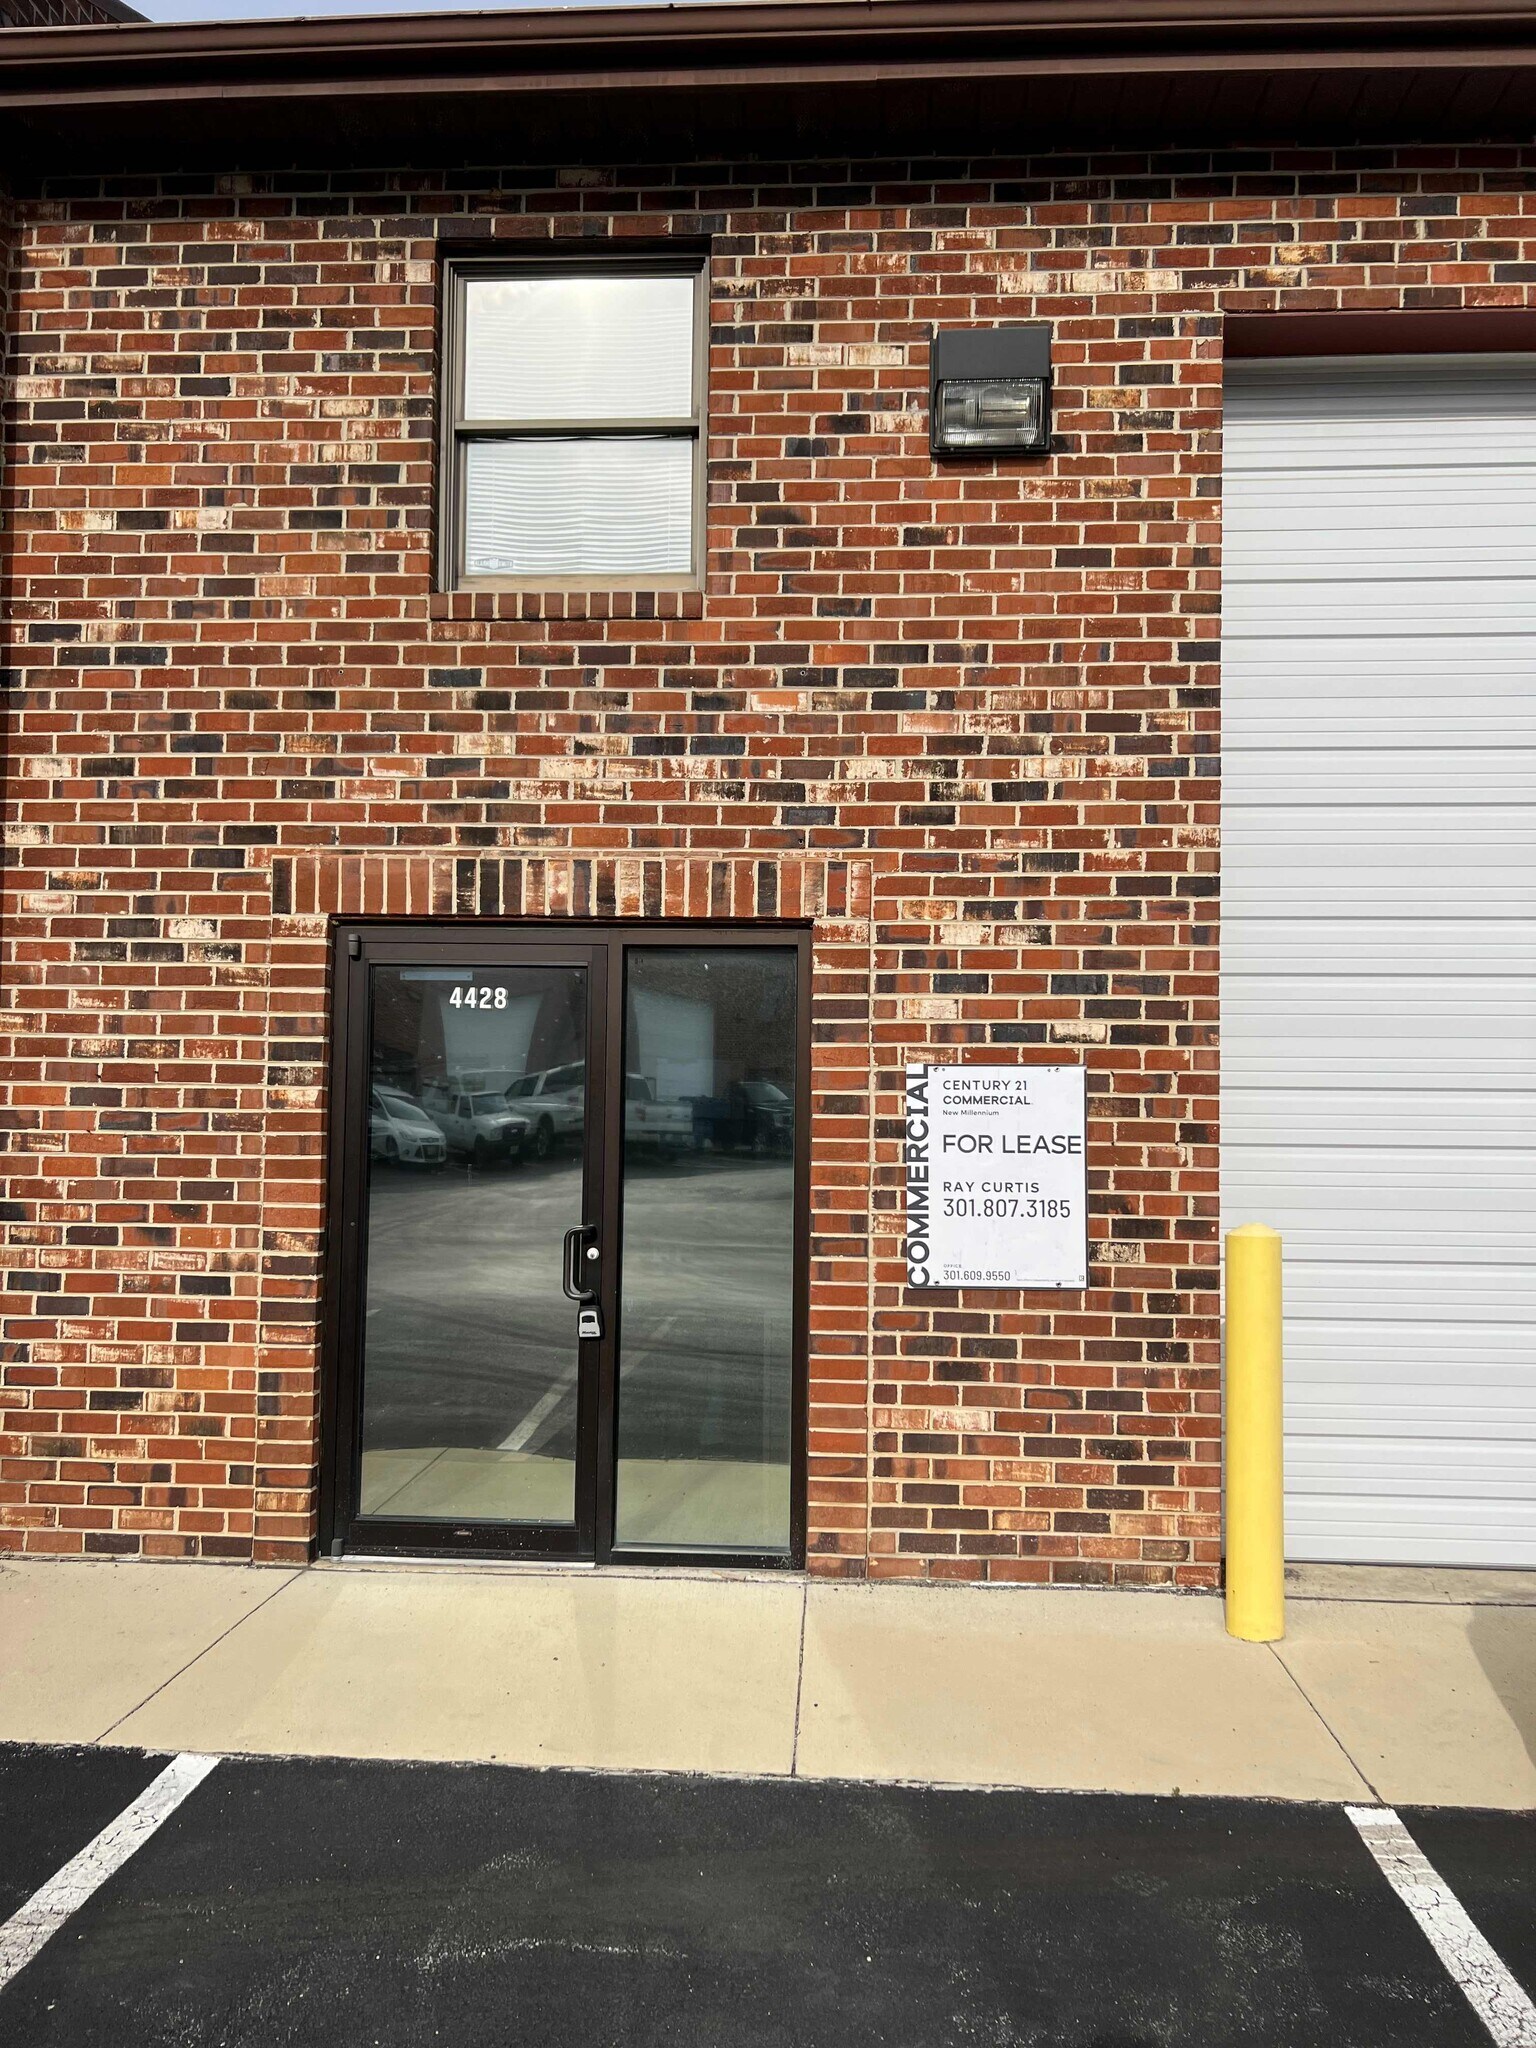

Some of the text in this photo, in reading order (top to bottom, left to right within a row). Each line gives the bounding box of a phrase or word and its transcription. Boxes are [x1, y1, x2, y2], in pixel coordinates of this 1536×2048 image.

[449, 986, 508, 1009] 4428
[942, 1079, 1027, 1091] CENTURY 21
[942, 1095, 1031, 1105] COMMERCIAL
[943, 1134, 1082, 1154] FOR LEASE
[906, 1064, 930, 1287] COMMERCIAL
[943, 1181, 1040, 1193] RAY CURTIS
[943, 1198, 1071, 1218] 301.807.3185
[943, 1270, 1011, 1281] 301.609.9550
